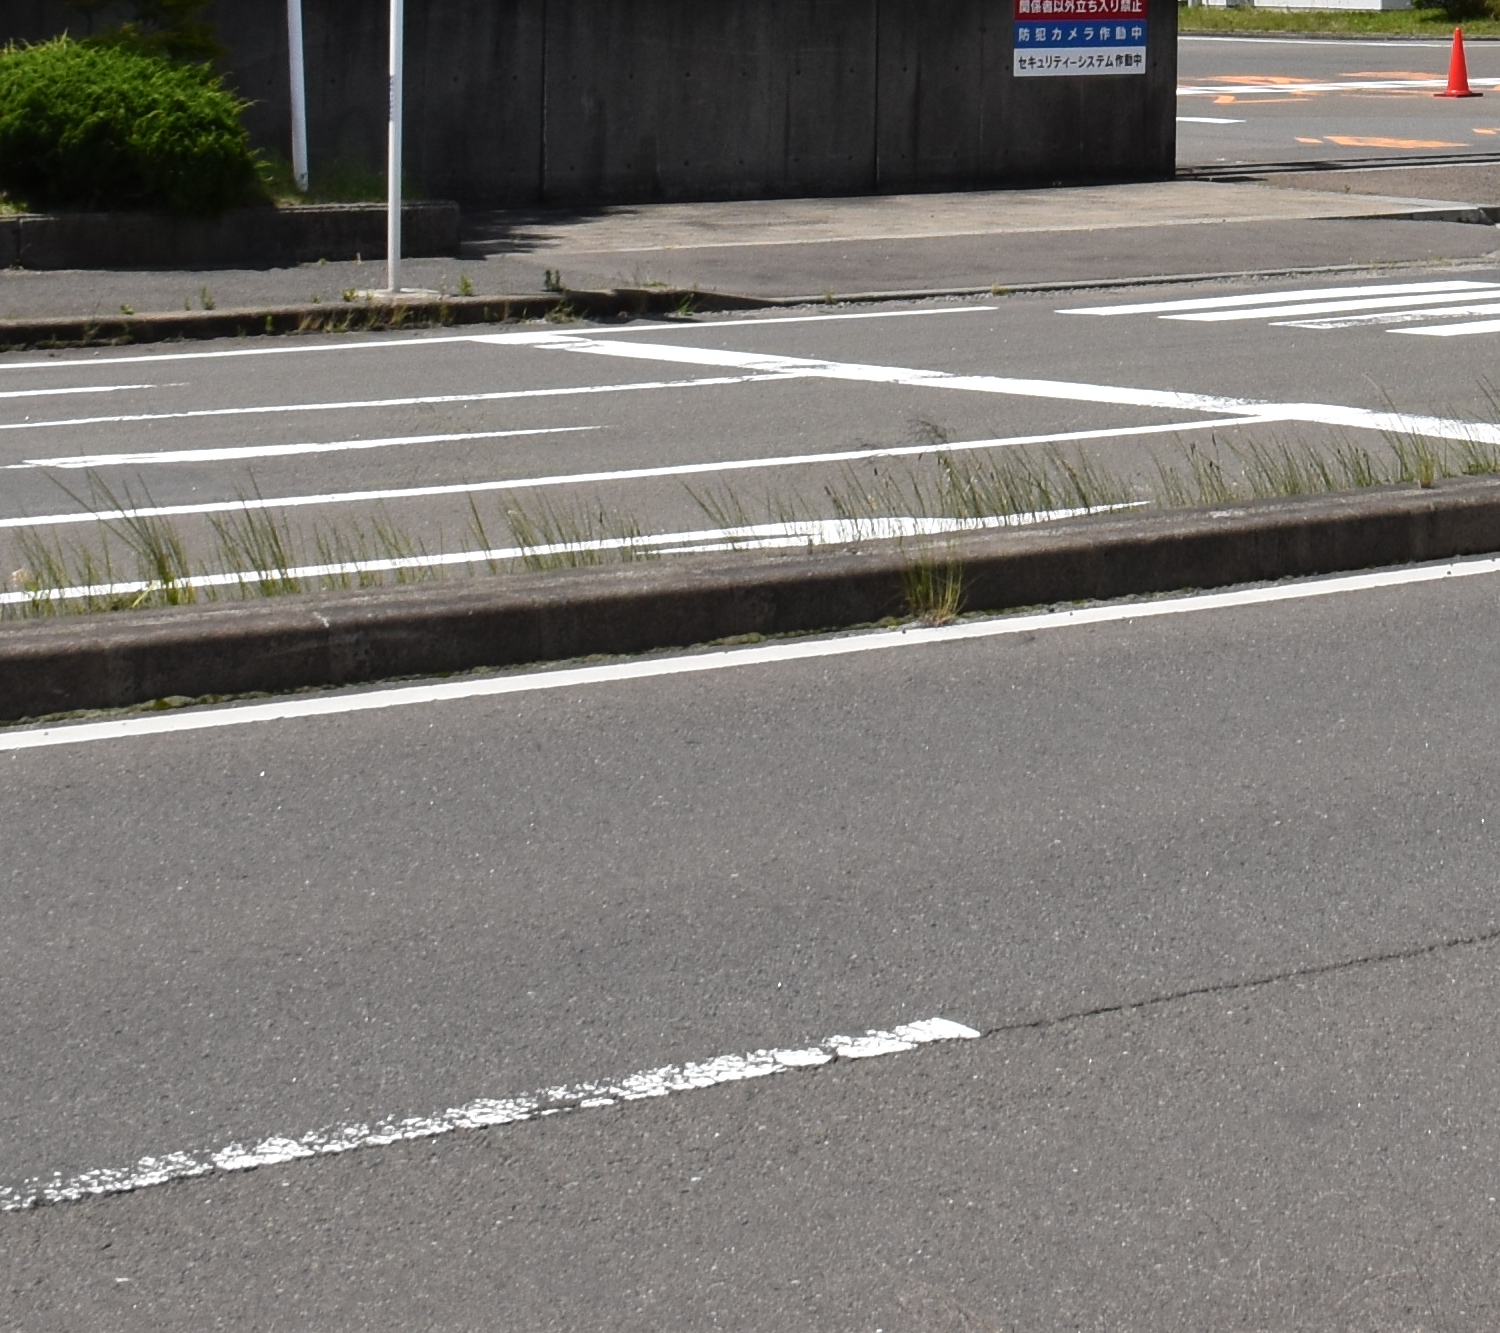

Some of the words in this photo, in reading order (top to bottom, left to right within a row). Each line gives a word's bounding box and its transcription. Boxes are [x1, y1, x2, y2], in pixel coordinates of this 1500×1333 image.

[1018, 25, 1142, 42] 防犯カメラ作動中
[1018, 52, 1143, 71] セキュリティーシステム作動中
